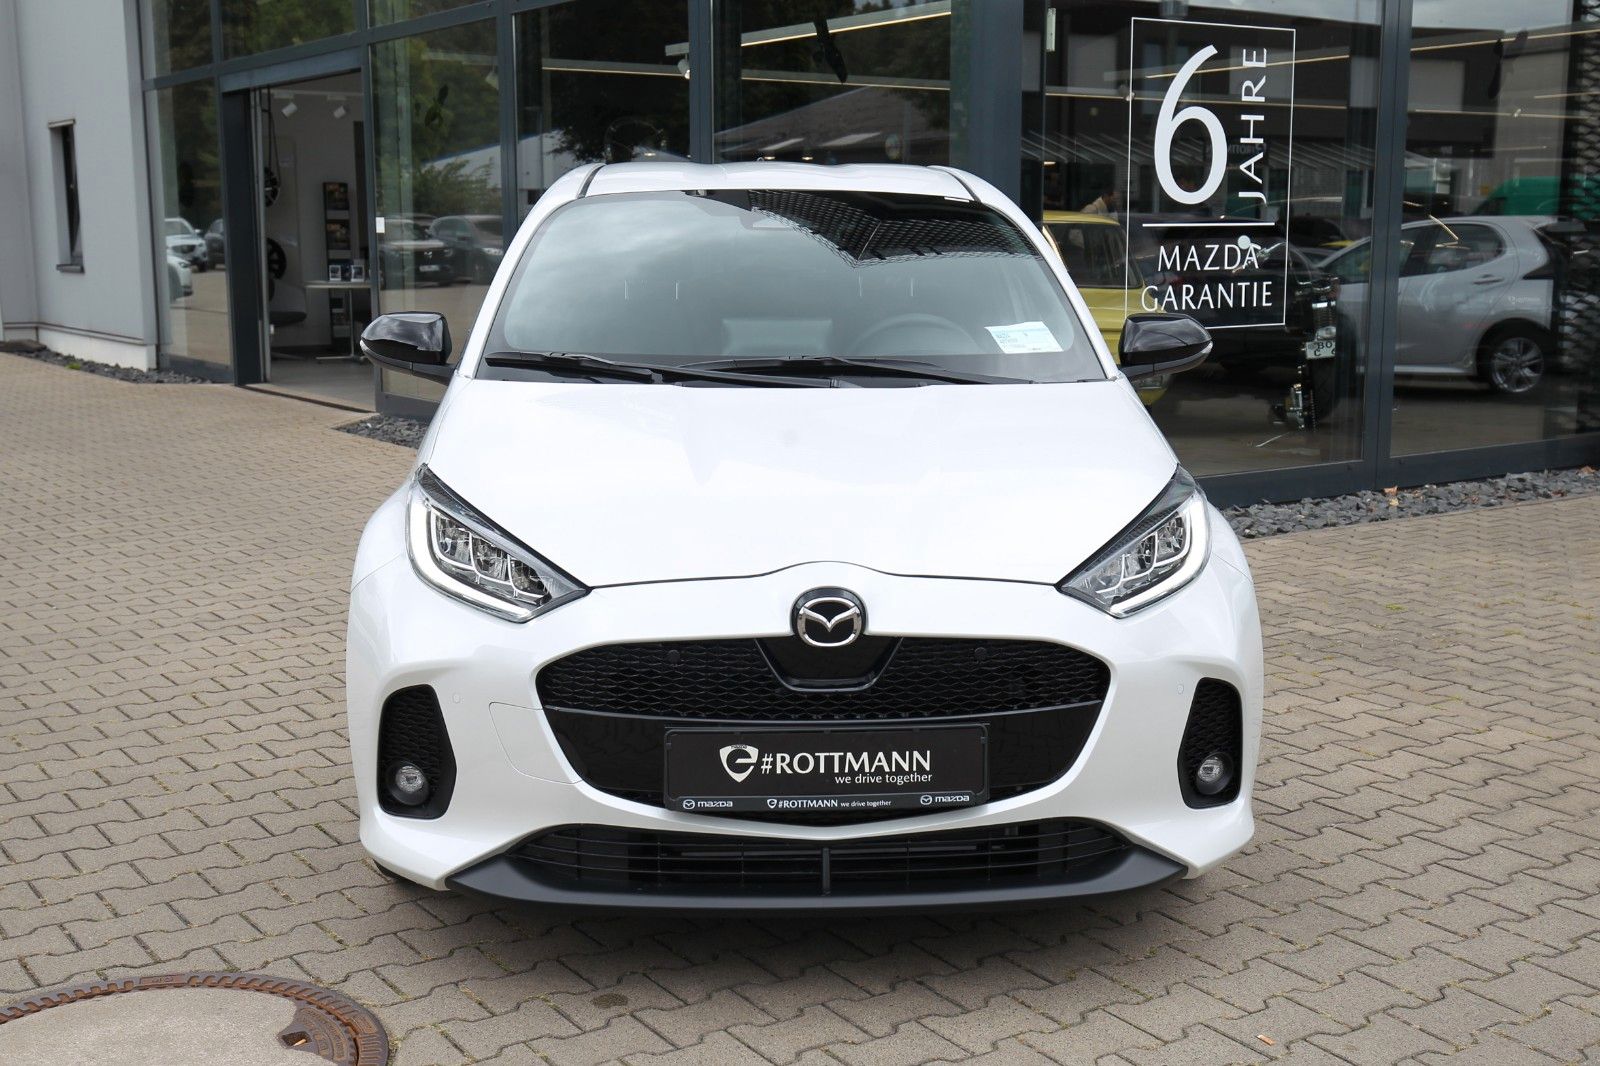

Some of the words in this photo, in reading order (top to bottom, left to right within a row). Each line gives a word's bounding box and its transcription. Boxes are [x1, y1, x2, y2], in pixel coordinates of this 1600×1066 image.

[1154, 44, 1228, 205] 6
[1238, 48, 1268, 206] JAHRE
[1157, 243, 1259, 272] MAZDA
[1141, 281, 1273, 312] GARANTIE
[760, 750, 931, 774] #ROTTMANN
[834, 776, 852, 784] we
[854, 773, 883, 784] drive
[885, 772, 932, 786] together
[697, 800, 734, 808] mazda
[778, 799, 838, 809] #ROTTMANN
[850, 800, 866, 808] drive
[866, 799, 892, 808] together
[935, 795, 970, 804] mazda
